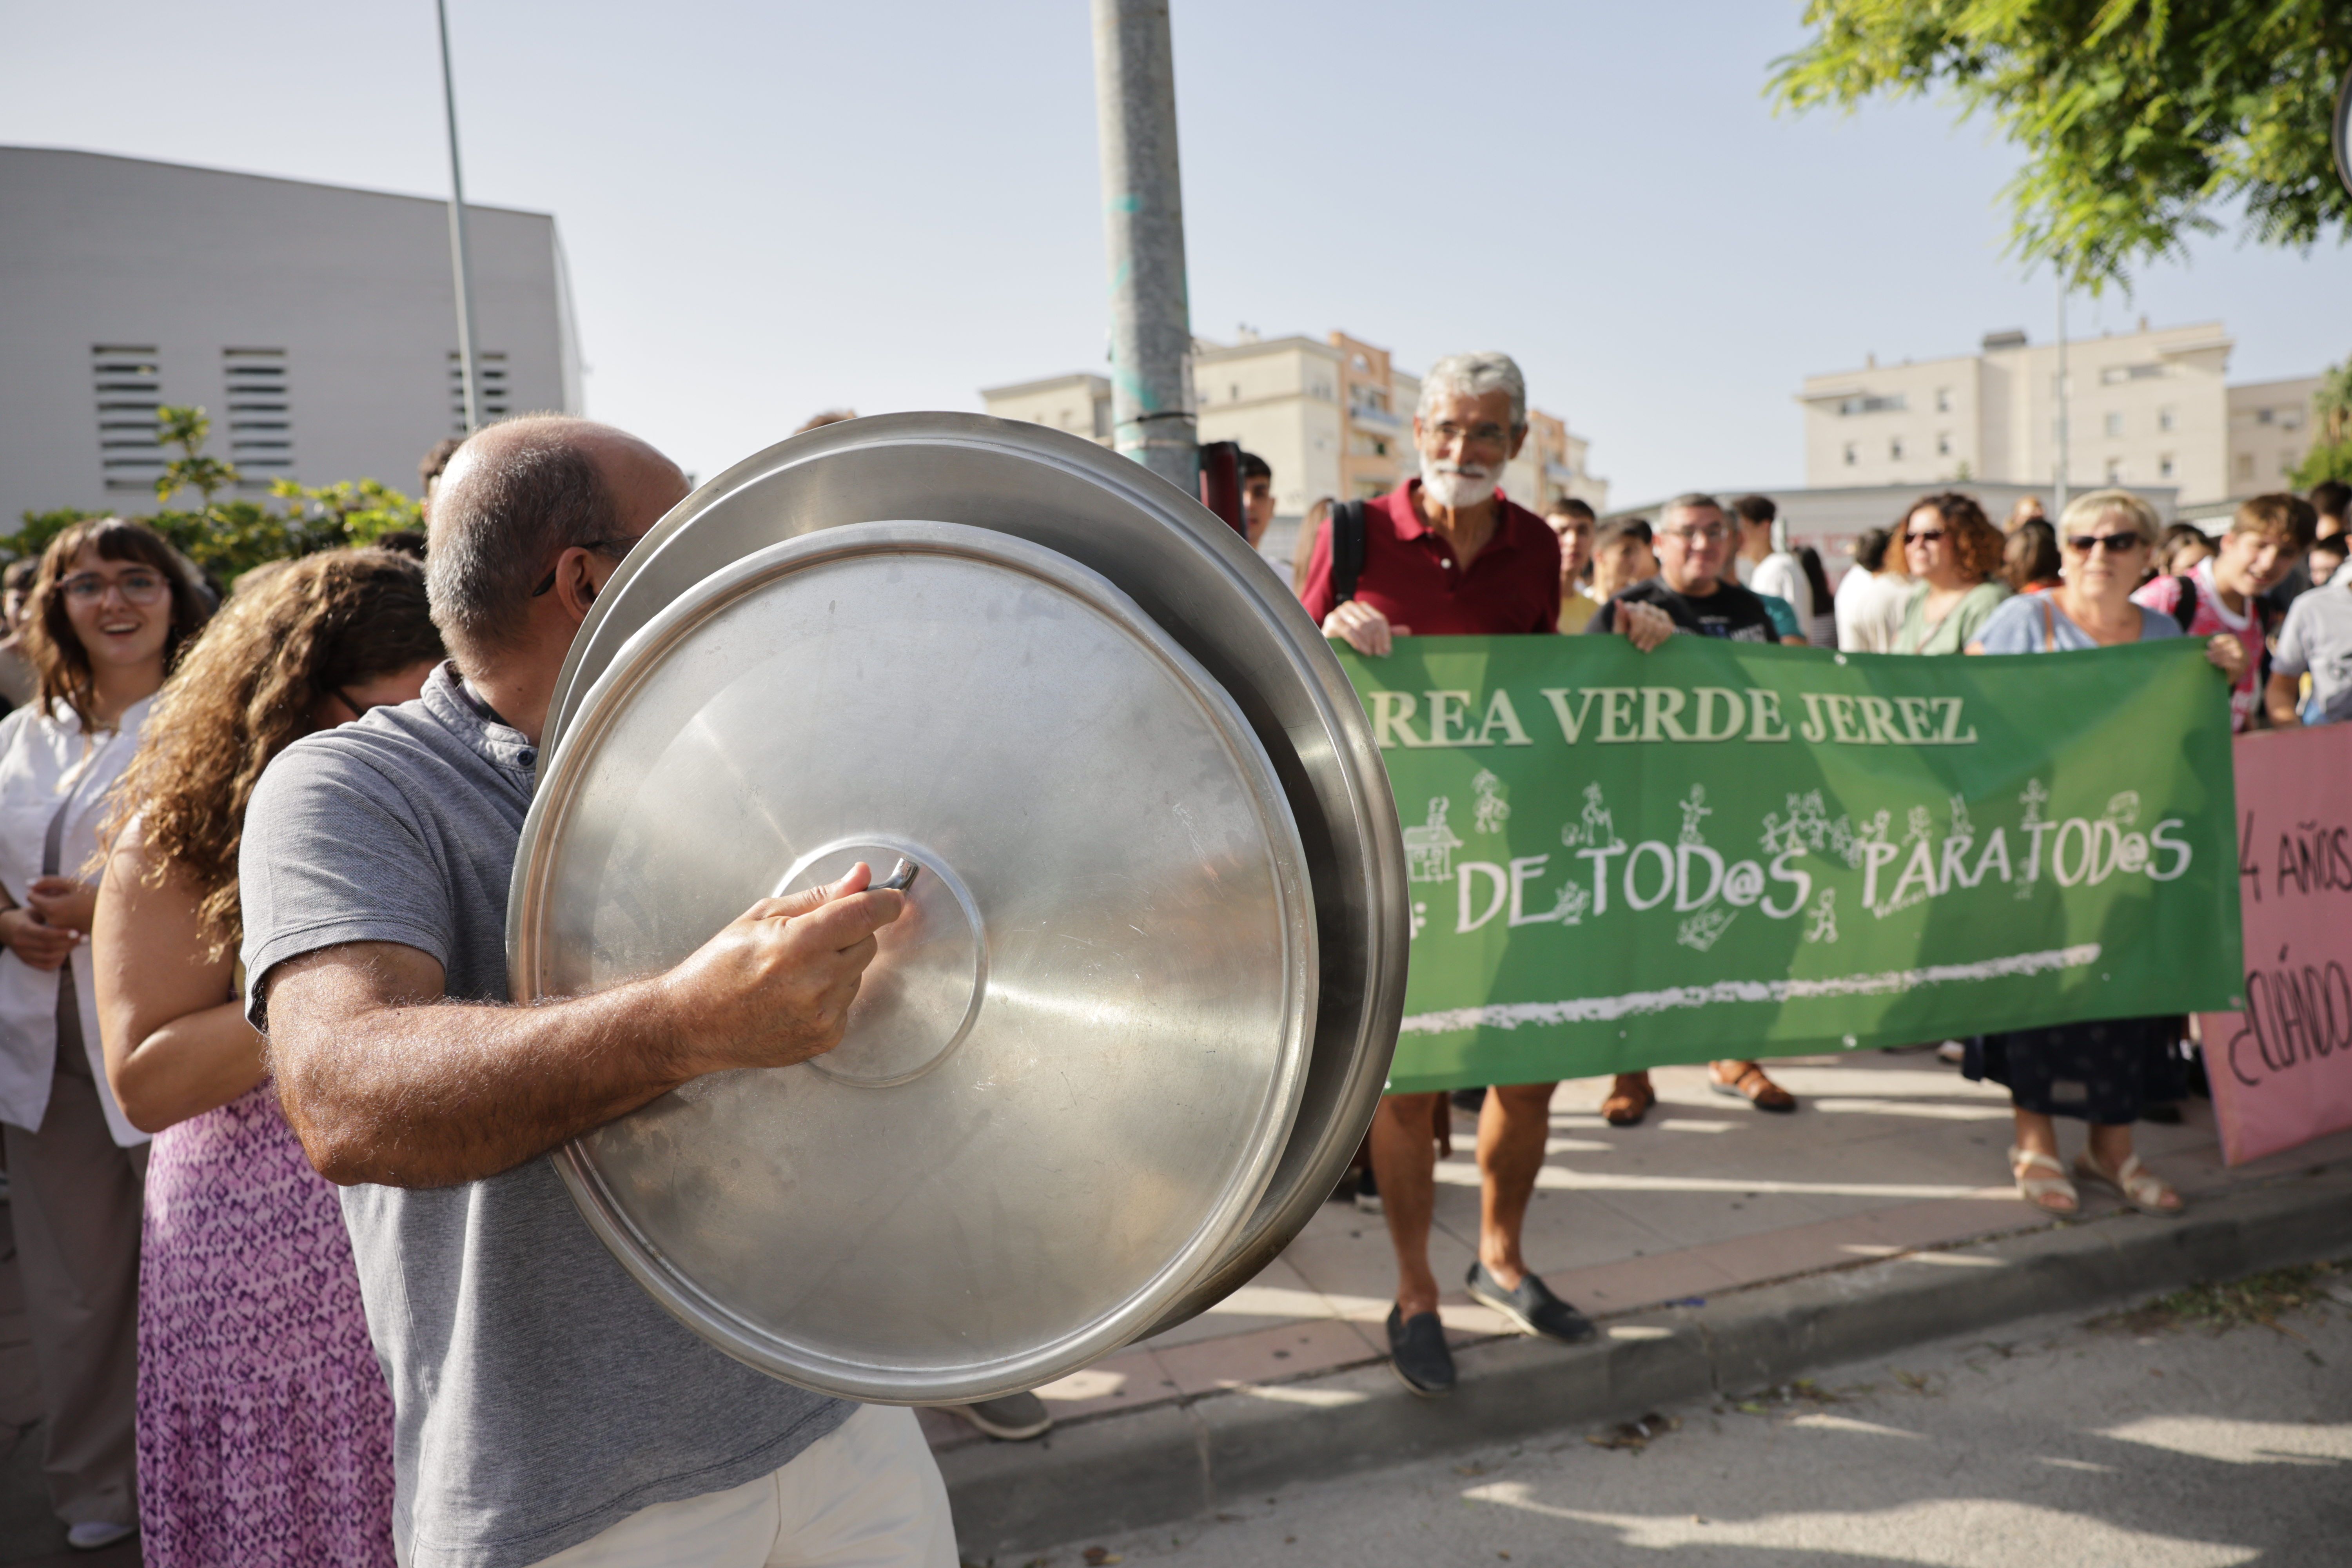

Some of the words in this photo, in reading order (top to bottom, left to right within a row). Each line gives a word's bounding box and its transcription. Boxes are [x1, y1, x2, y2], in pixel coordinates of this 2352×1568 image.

[1540, 686, 1790, 744] VERDE
[1799, 692, 1978, 745] JEREZ
[1454, 854, 1562, 934] DE
[1575, 840, 1812, 919] TOD@S
[1862, 826, 2012, 908] PARA
[2020, 817, 2193, 887] TOD@S
[2277, 818, 2352, 897] AÑOS
